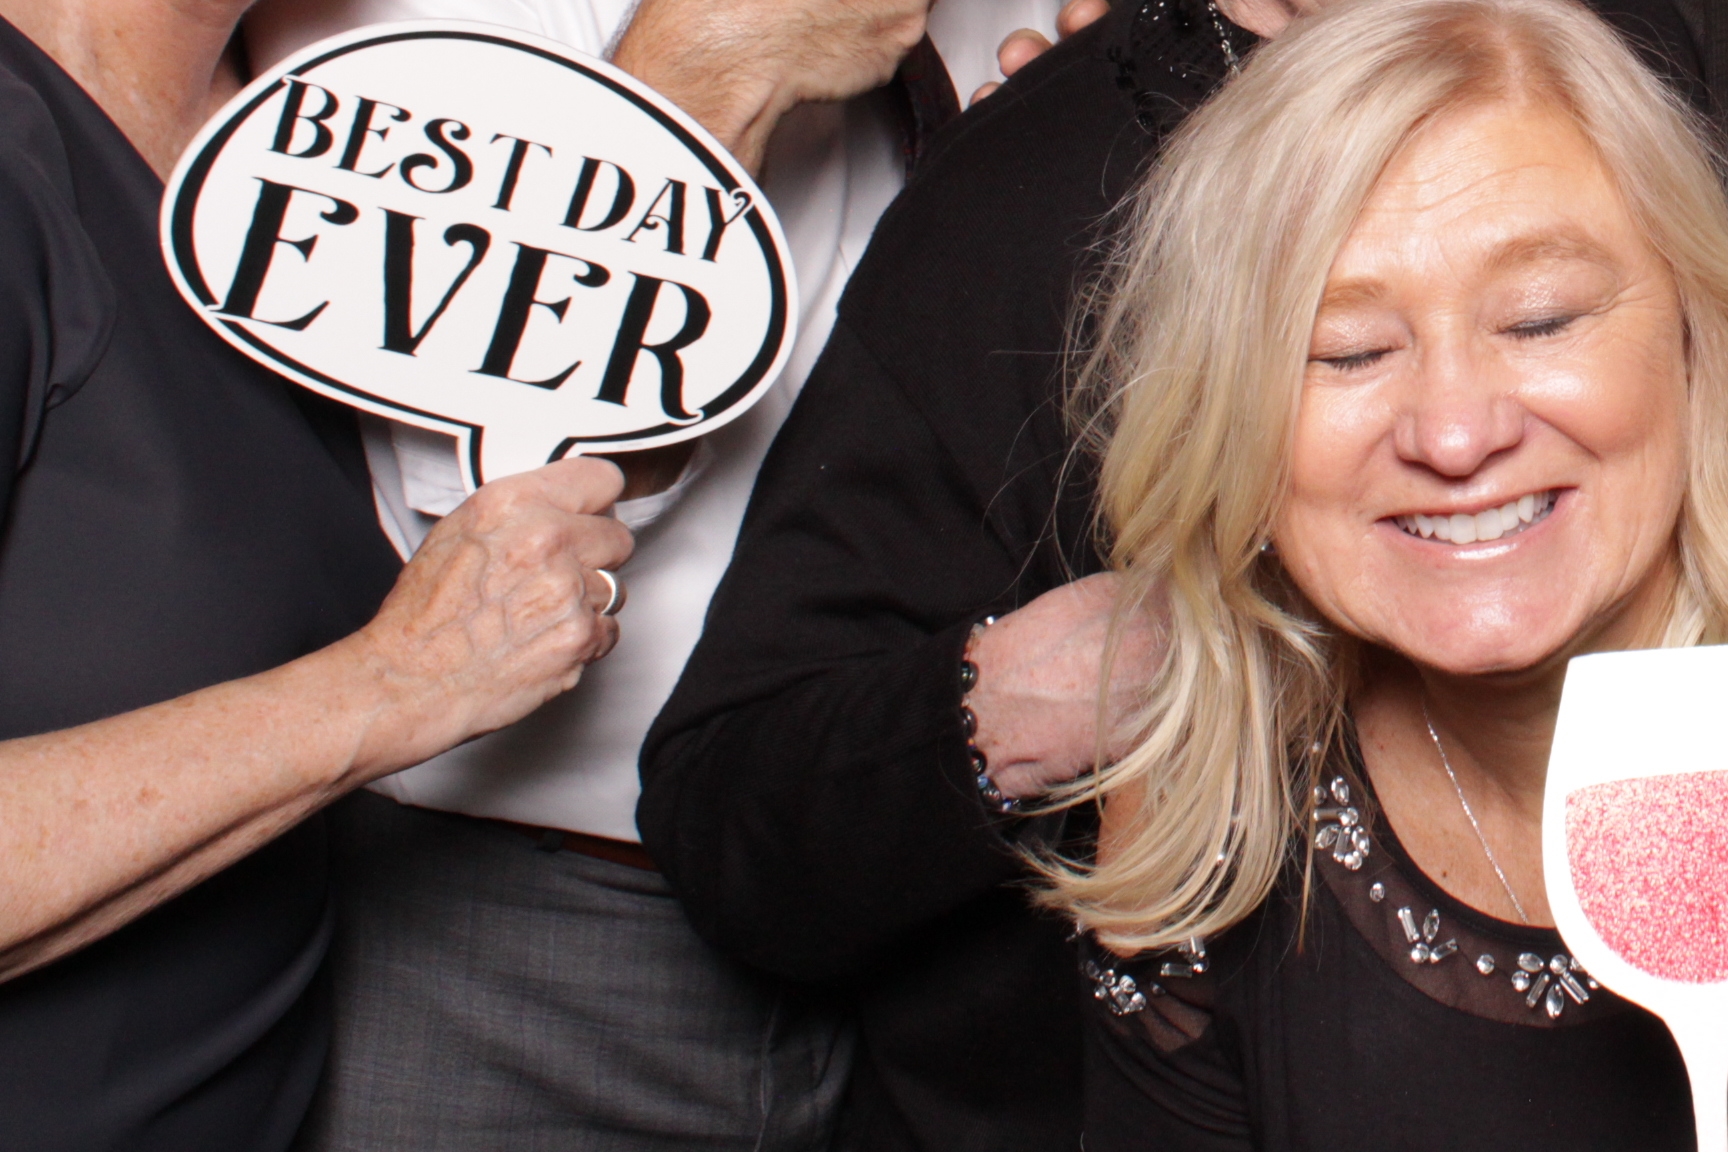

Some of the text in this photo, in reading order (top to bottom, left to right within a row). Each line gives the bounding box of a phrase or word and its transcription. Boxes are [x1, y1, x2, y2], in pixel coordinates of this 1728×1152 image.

[265, 78, 753, 263] BEST DAY
[212, 176, 712, 423] EVER
